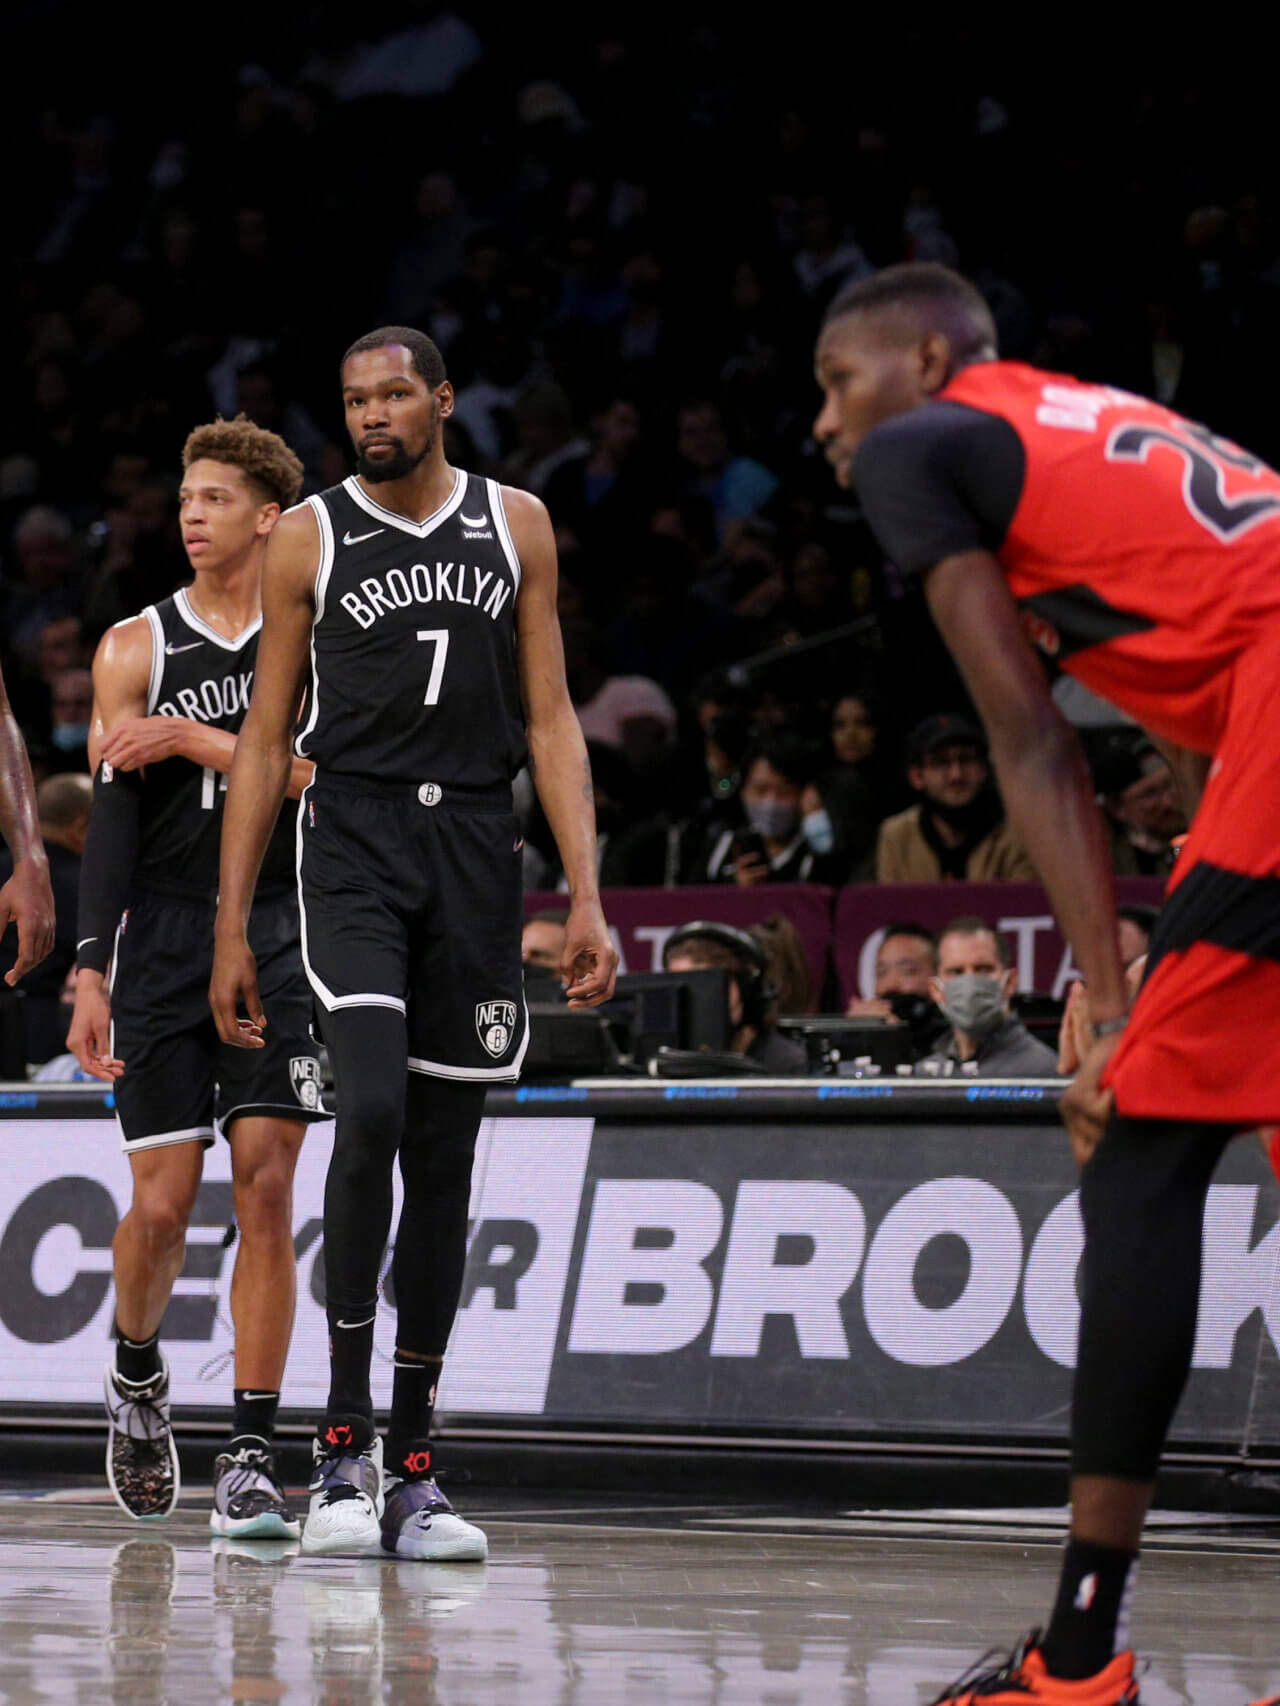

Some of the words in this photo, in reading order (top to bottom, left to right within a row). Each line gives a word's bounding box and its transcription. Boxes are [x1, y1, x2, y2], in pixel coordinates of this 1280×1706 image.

[464, 530, 493, 539] Webull
[340, 562, 511, 630] BROOKLYN
[416, 629, 449, 705] 7
[478, 1003, 516, 1026] NETS
